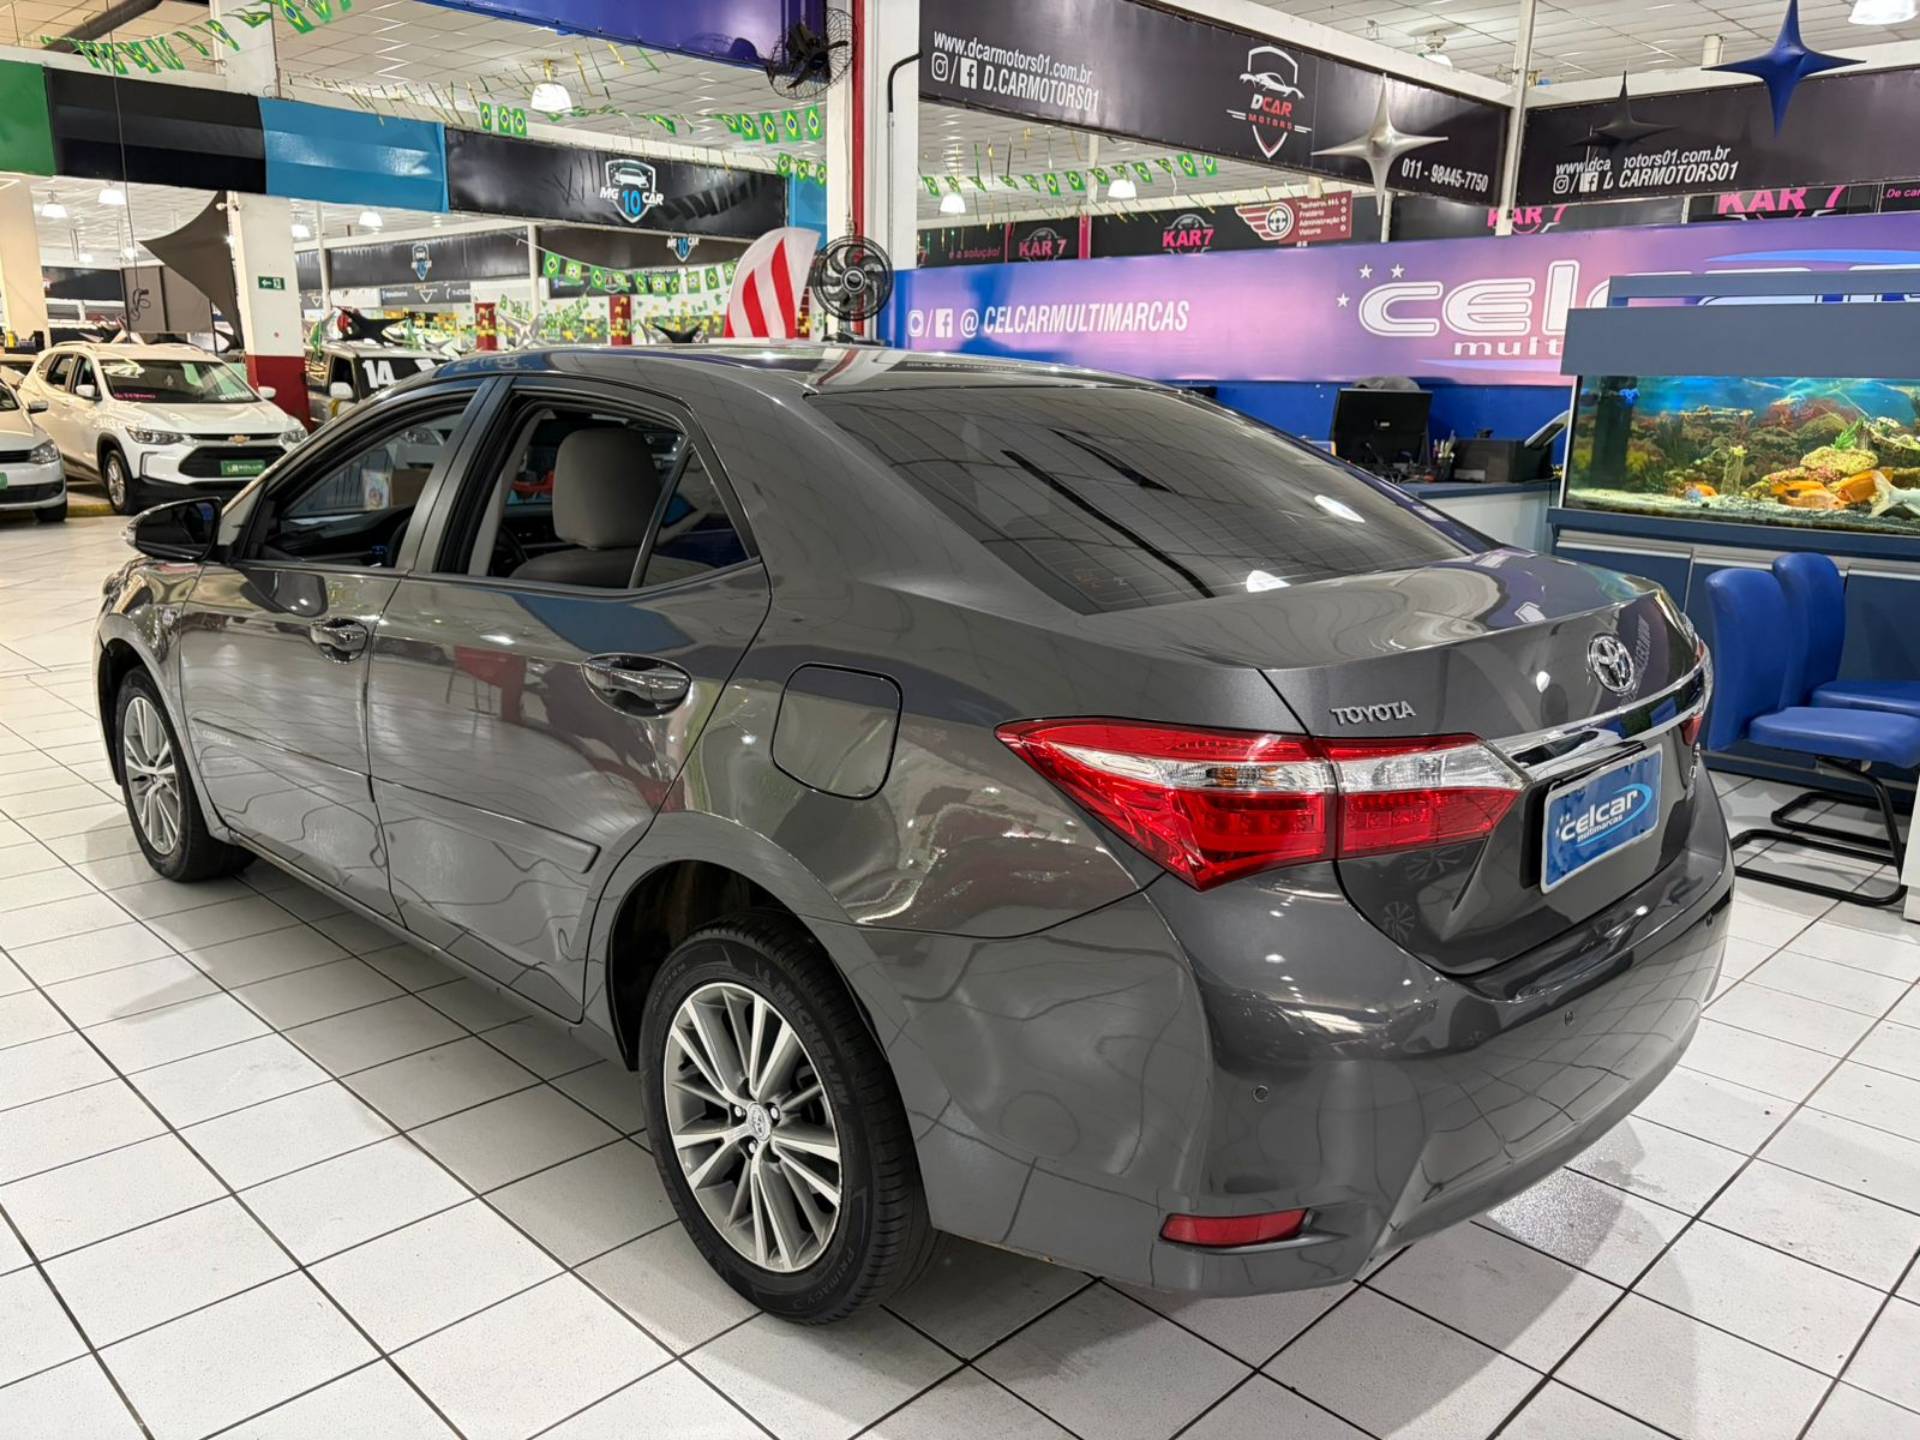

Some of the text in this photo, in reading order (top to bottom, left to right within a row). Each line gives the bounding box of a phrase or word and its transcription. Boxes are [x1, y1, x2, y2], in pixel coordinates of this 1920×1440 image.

[934, 31, 1092, 84] www.dcarmotors01.com.br
[983, 66, 1100, 112] D.CARMOTORS01
[1250, 93, 1293, 117] DCAR
[1248, 113, 1293, 131] MOTORS
[1401, 158, 1423, 180] 011
[1430, 164, 1489, 192] 98445-7750
[1556, 145, 1731, 176] www.dcaotors01.com.br
[1603, 161, 1739, 190] DCARMOTORS01
[600, 187, 664, 217] MG 10 CAR
[1718, 187, 1808, 214] KAR
[1019, 238, 1068, 258] KAR 7
[1162, 228, 1215, 247] KAR 7
[960, 300, 1189, 338] @ CELCARMULTIMARCAS
[1330, 701, 1416, 725] TOYOTA
[1560, 789, 1638, 842] celcar
[773, 981, 851, 1104] MICHELIN
